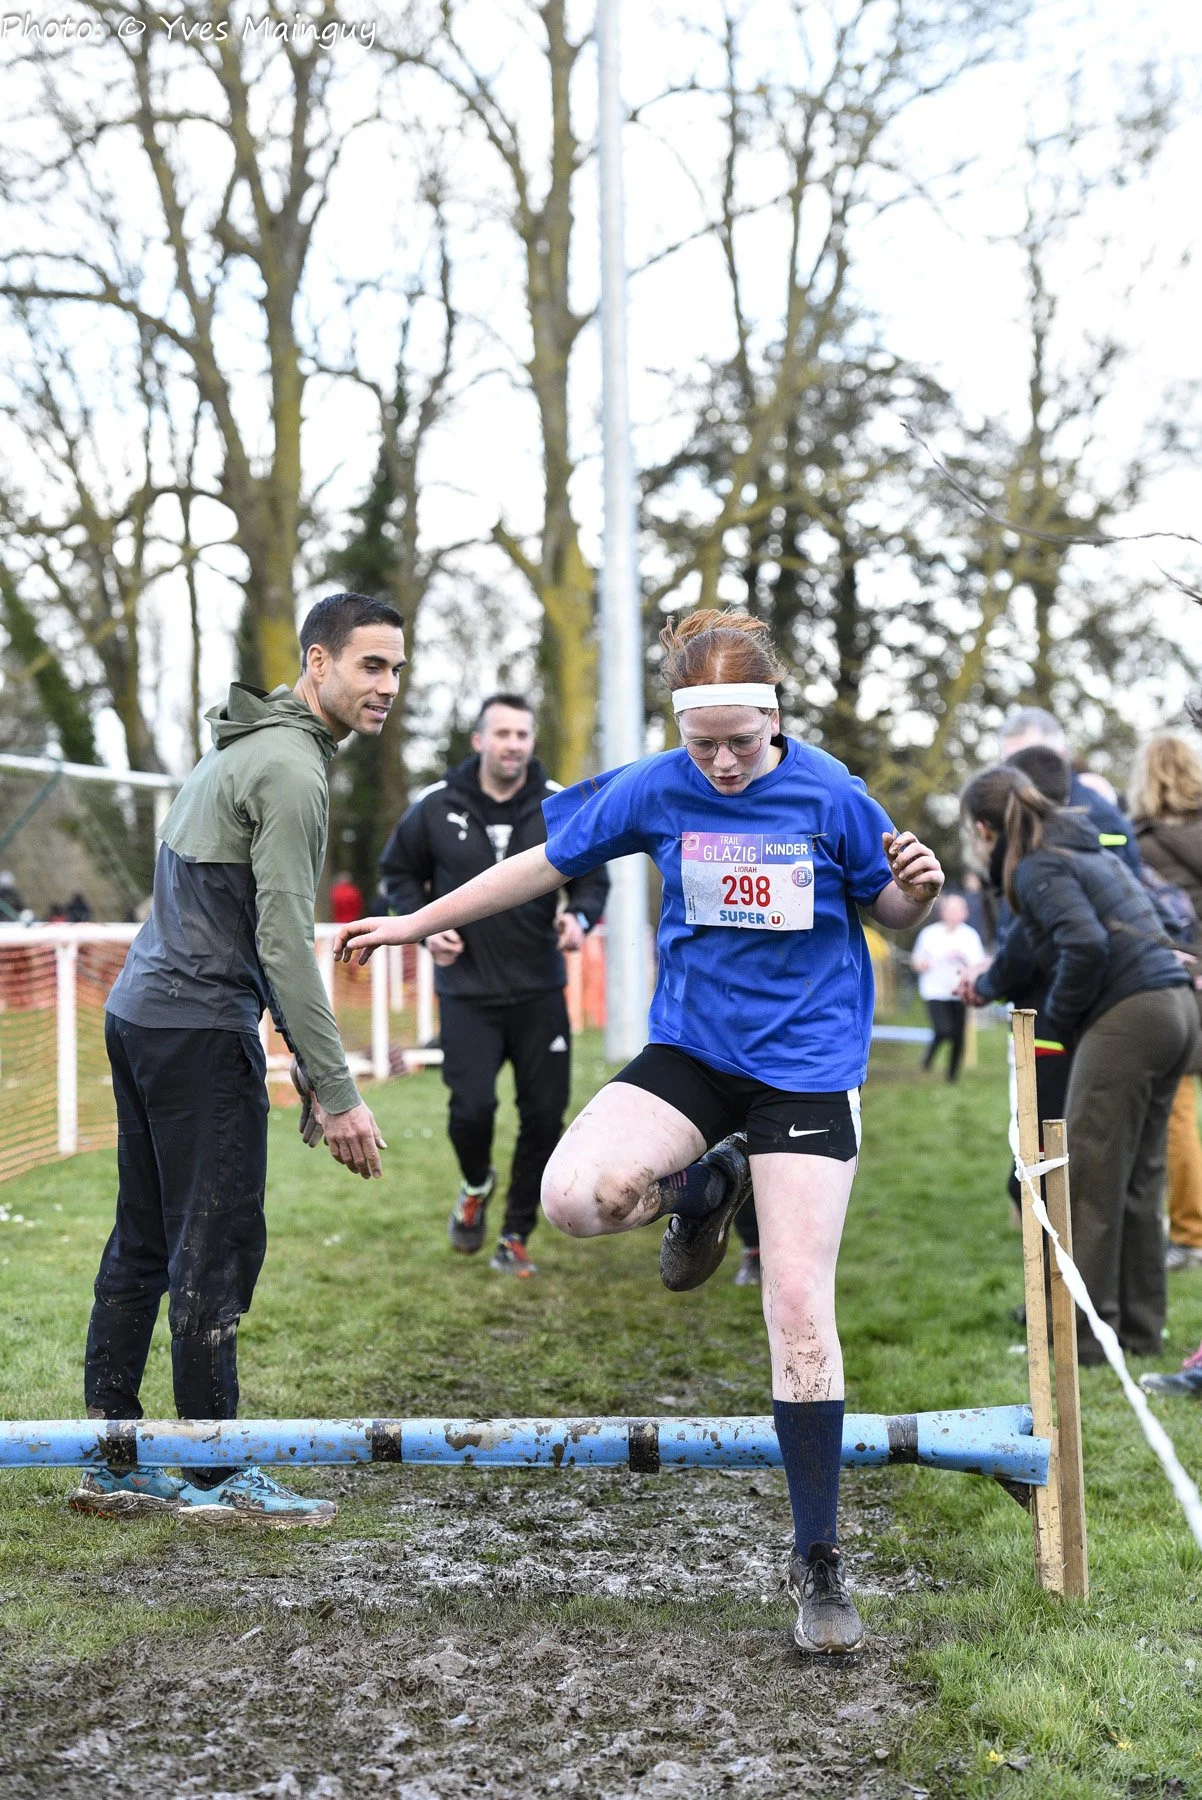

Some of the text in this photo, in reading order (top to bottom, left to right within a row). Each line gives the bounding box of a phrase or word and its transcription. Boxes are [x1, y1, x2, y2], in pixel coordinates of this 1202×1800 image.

[720, 835, 739, 846] TRAIL
[703, 845, 757, 862] GLAZIG
[765, 843, 808, 856] KINDER
[722, 875, 771, 907] 298
[719, 910, 781, 925] SUPER U
